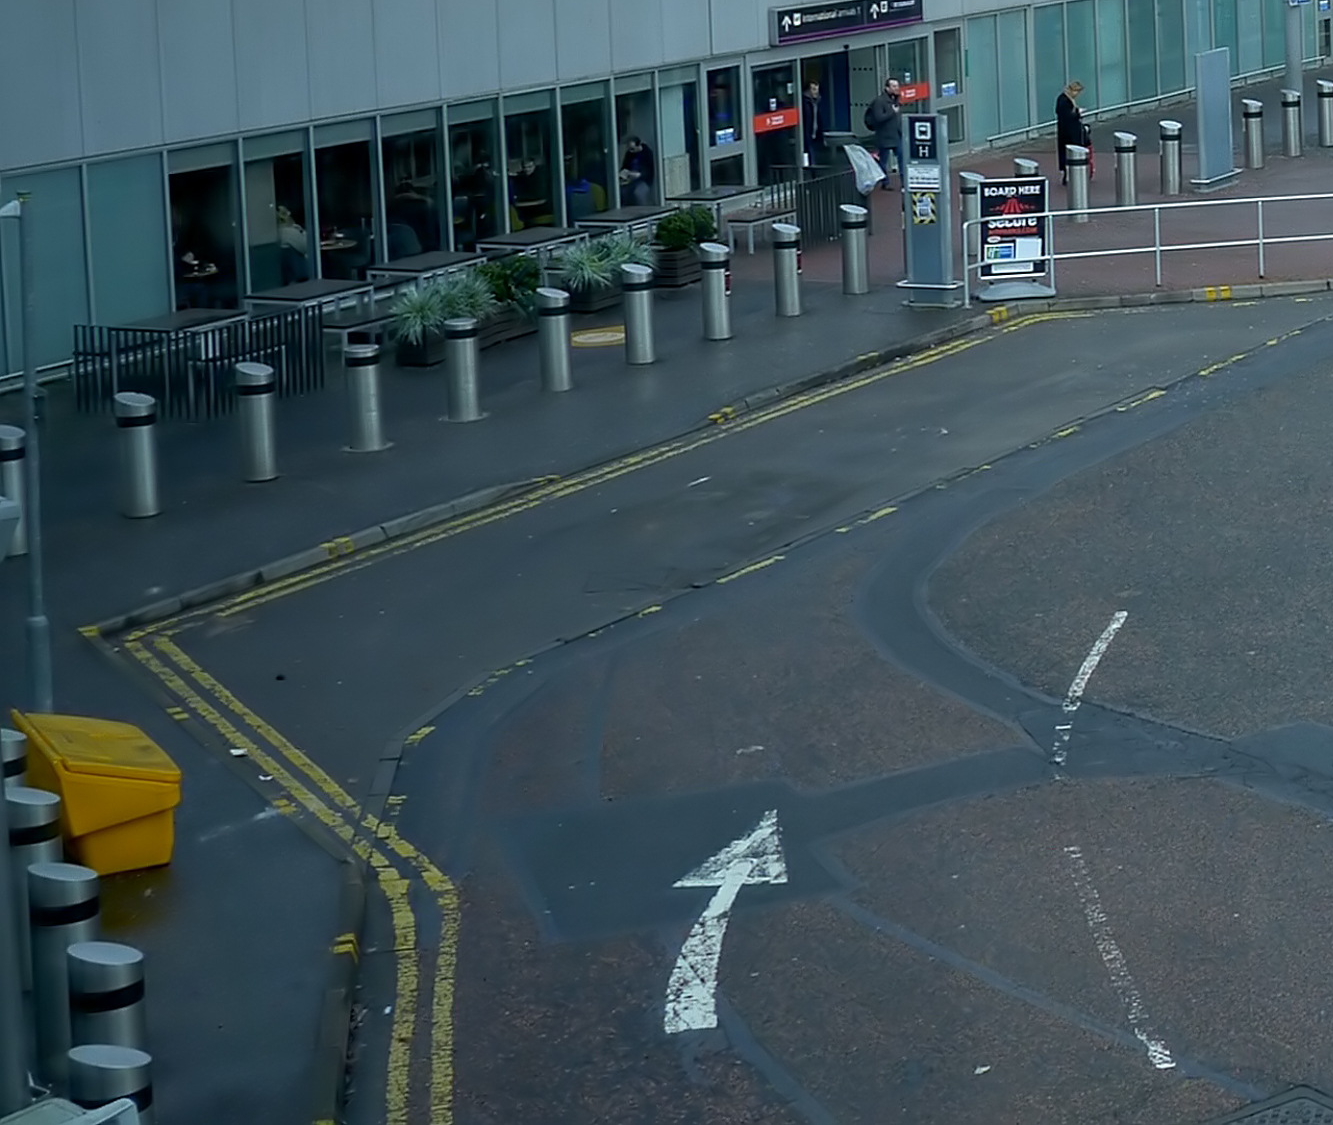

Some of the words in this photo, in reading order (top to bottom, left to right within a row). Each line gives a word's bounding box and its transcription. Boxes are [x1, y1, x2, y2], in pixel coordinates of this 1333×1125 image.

[918, 145, 929, 158] H
[983, 186, 1017, 197] BOARD
[1018, 185, 1041, 196] HERE
